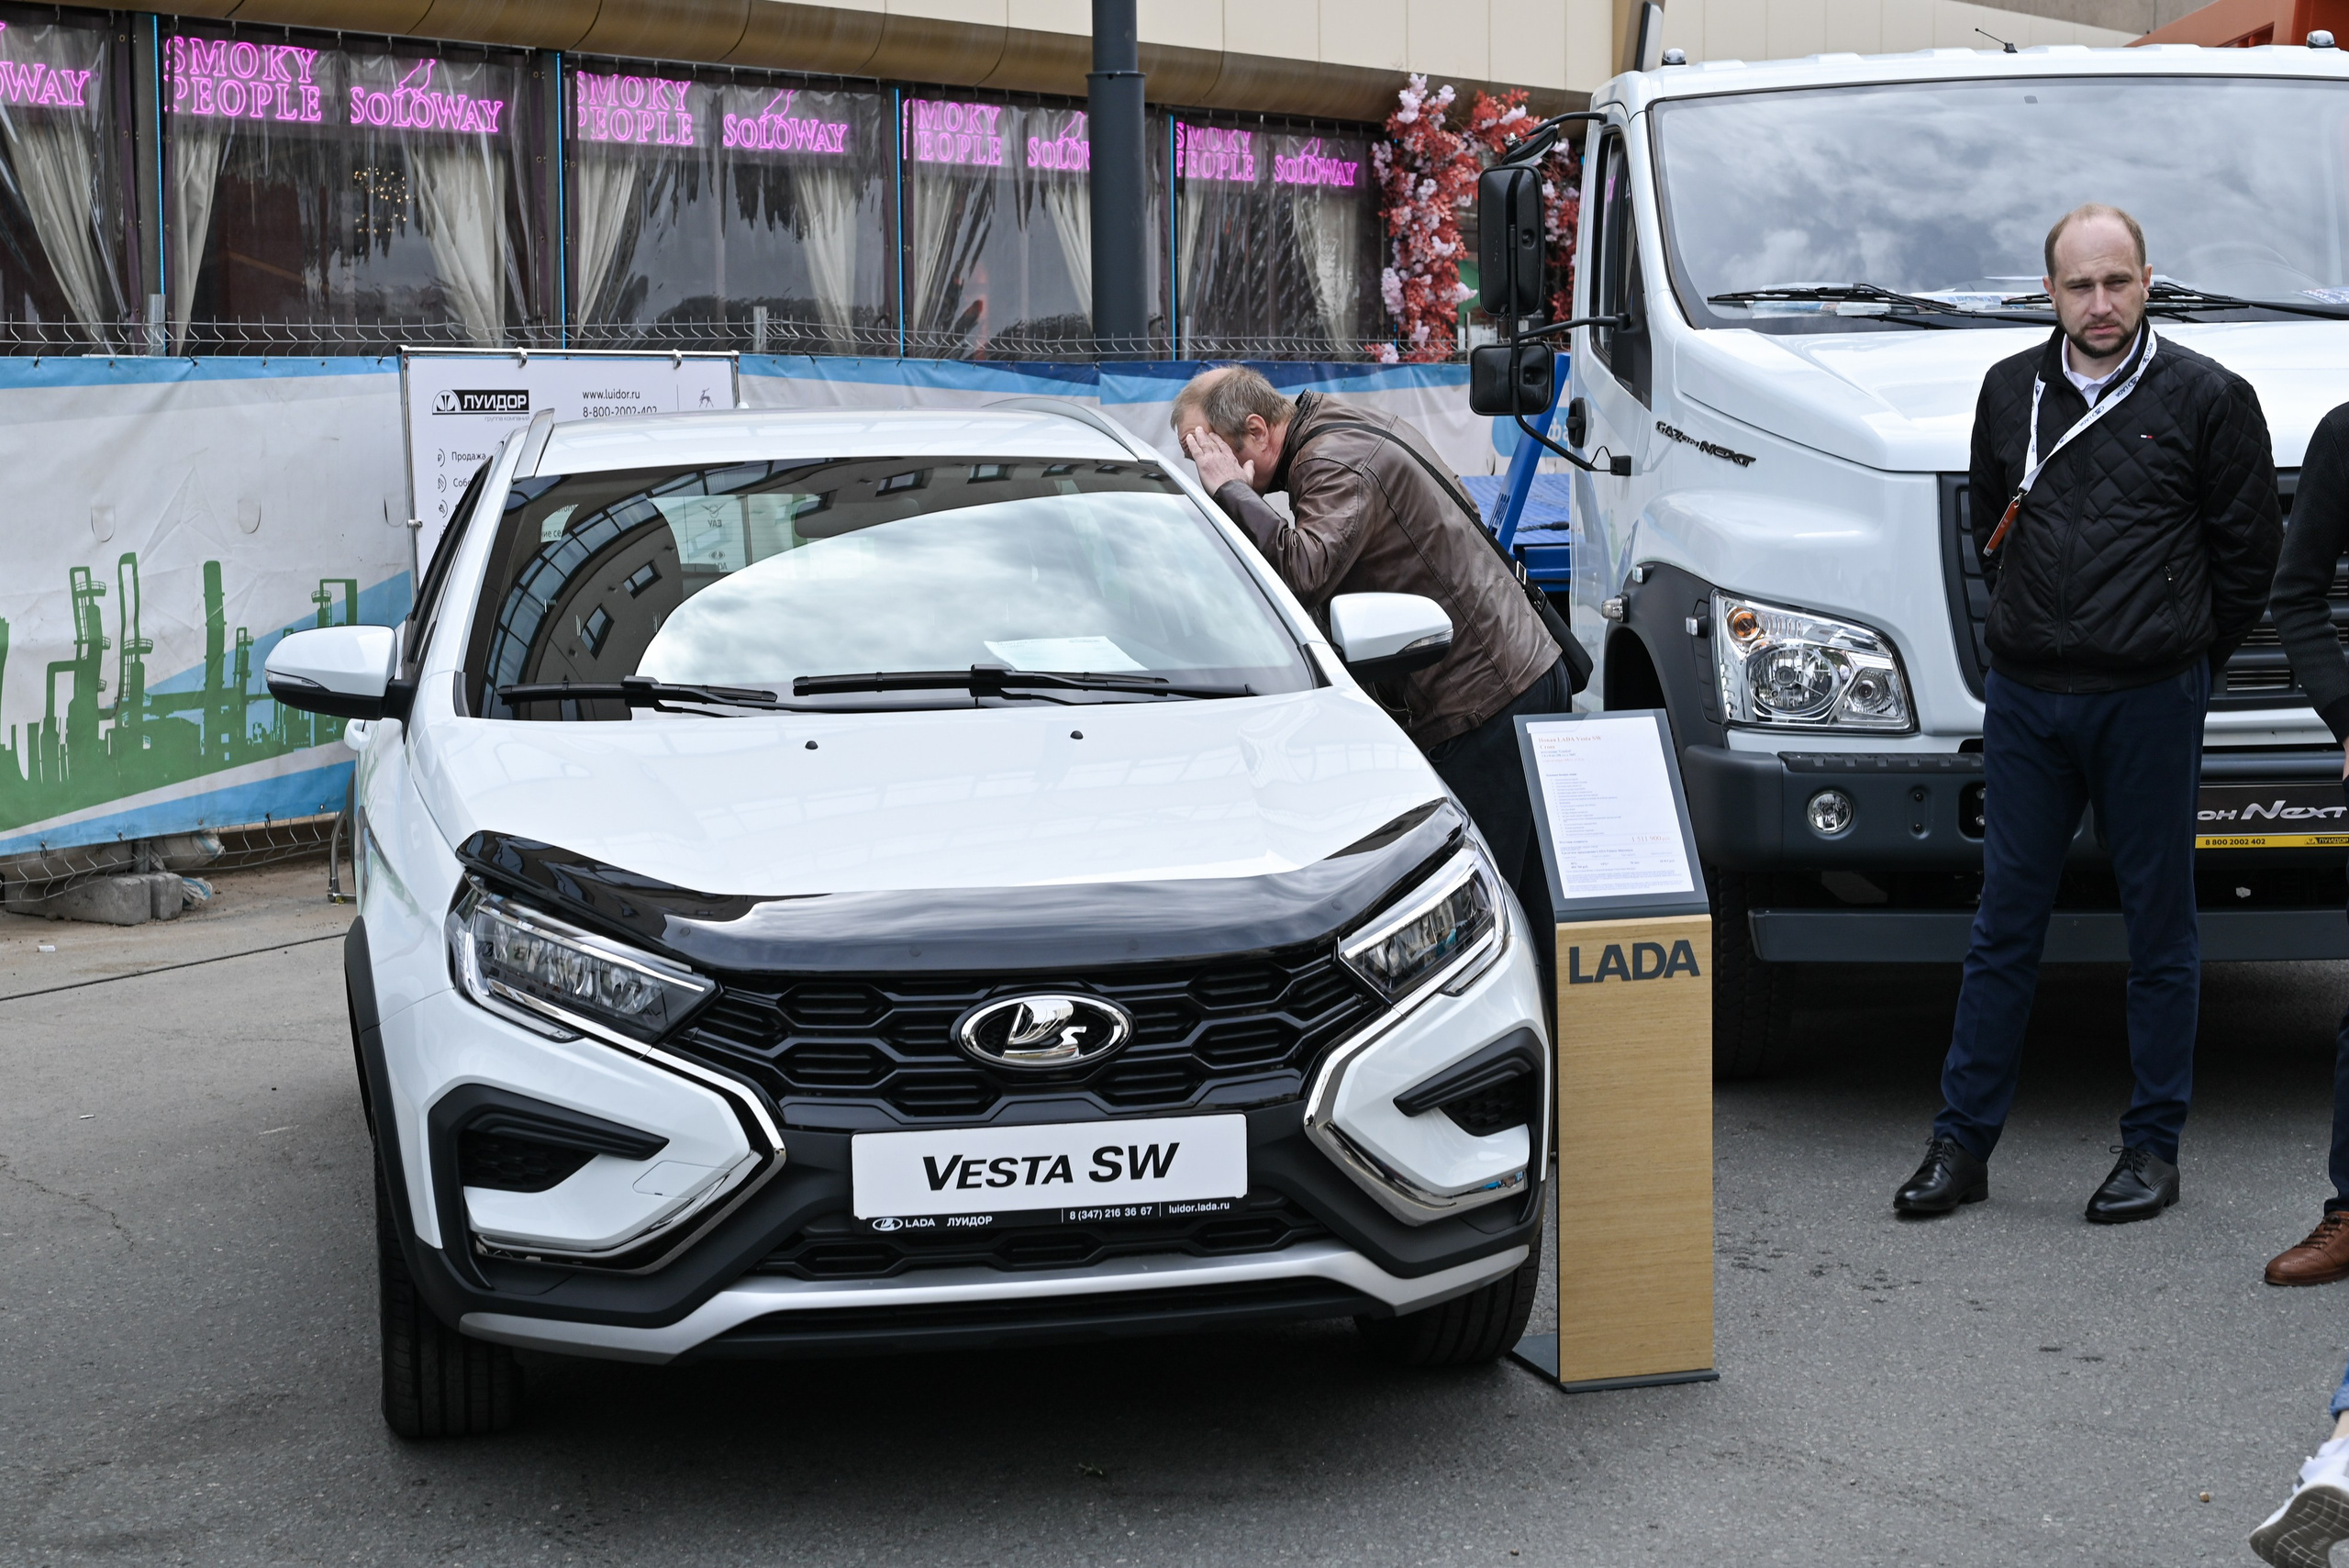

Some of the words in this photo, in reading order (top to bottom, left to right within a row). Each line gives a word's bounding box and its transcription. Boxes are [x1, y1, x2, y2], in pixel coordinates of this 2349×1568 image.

[0, 61, 90, 106] WAY
[351, 86, 504, 132] SOLOWAY
[723, 113, 848, 152] SOLOWAY
[1176, 121, 1252, 154] SMOKY
[1175, 150, 1255, 182] PEOPLE
[1274, 154, 1359, 186] SOLOWAY
[463, 395, 528, 412] ЛУИДОР
[582, 388, 640, 400] www.luidor.ru
[451, 451, 486, 462] Продажа
[2212, 838, 2228, 846] 800
[2229, 838, 2249, 846] 2002
[2251, 838, 2266, 846] 402
[1569, 940, 1701, 984] LADA
[922, 1153, 1074, 1192] VESTA
[1088, 1142, 1181, 1182] SW
[905, 1218, 936, 1229] LADA
[947, 1215, 993, 1228] ЛУИДОР
[1069, 1211, 1076, 1220] 8
[1077, 1209, 1103, 1221] (347)
[1105, 1208, 1121, 1218] 216
[1124, 1207, 1137, 1217] 36
[1140, 1206, 1152, 1216] 67
[1168, 1201, 1230, 1214] luidor.lada.ru
